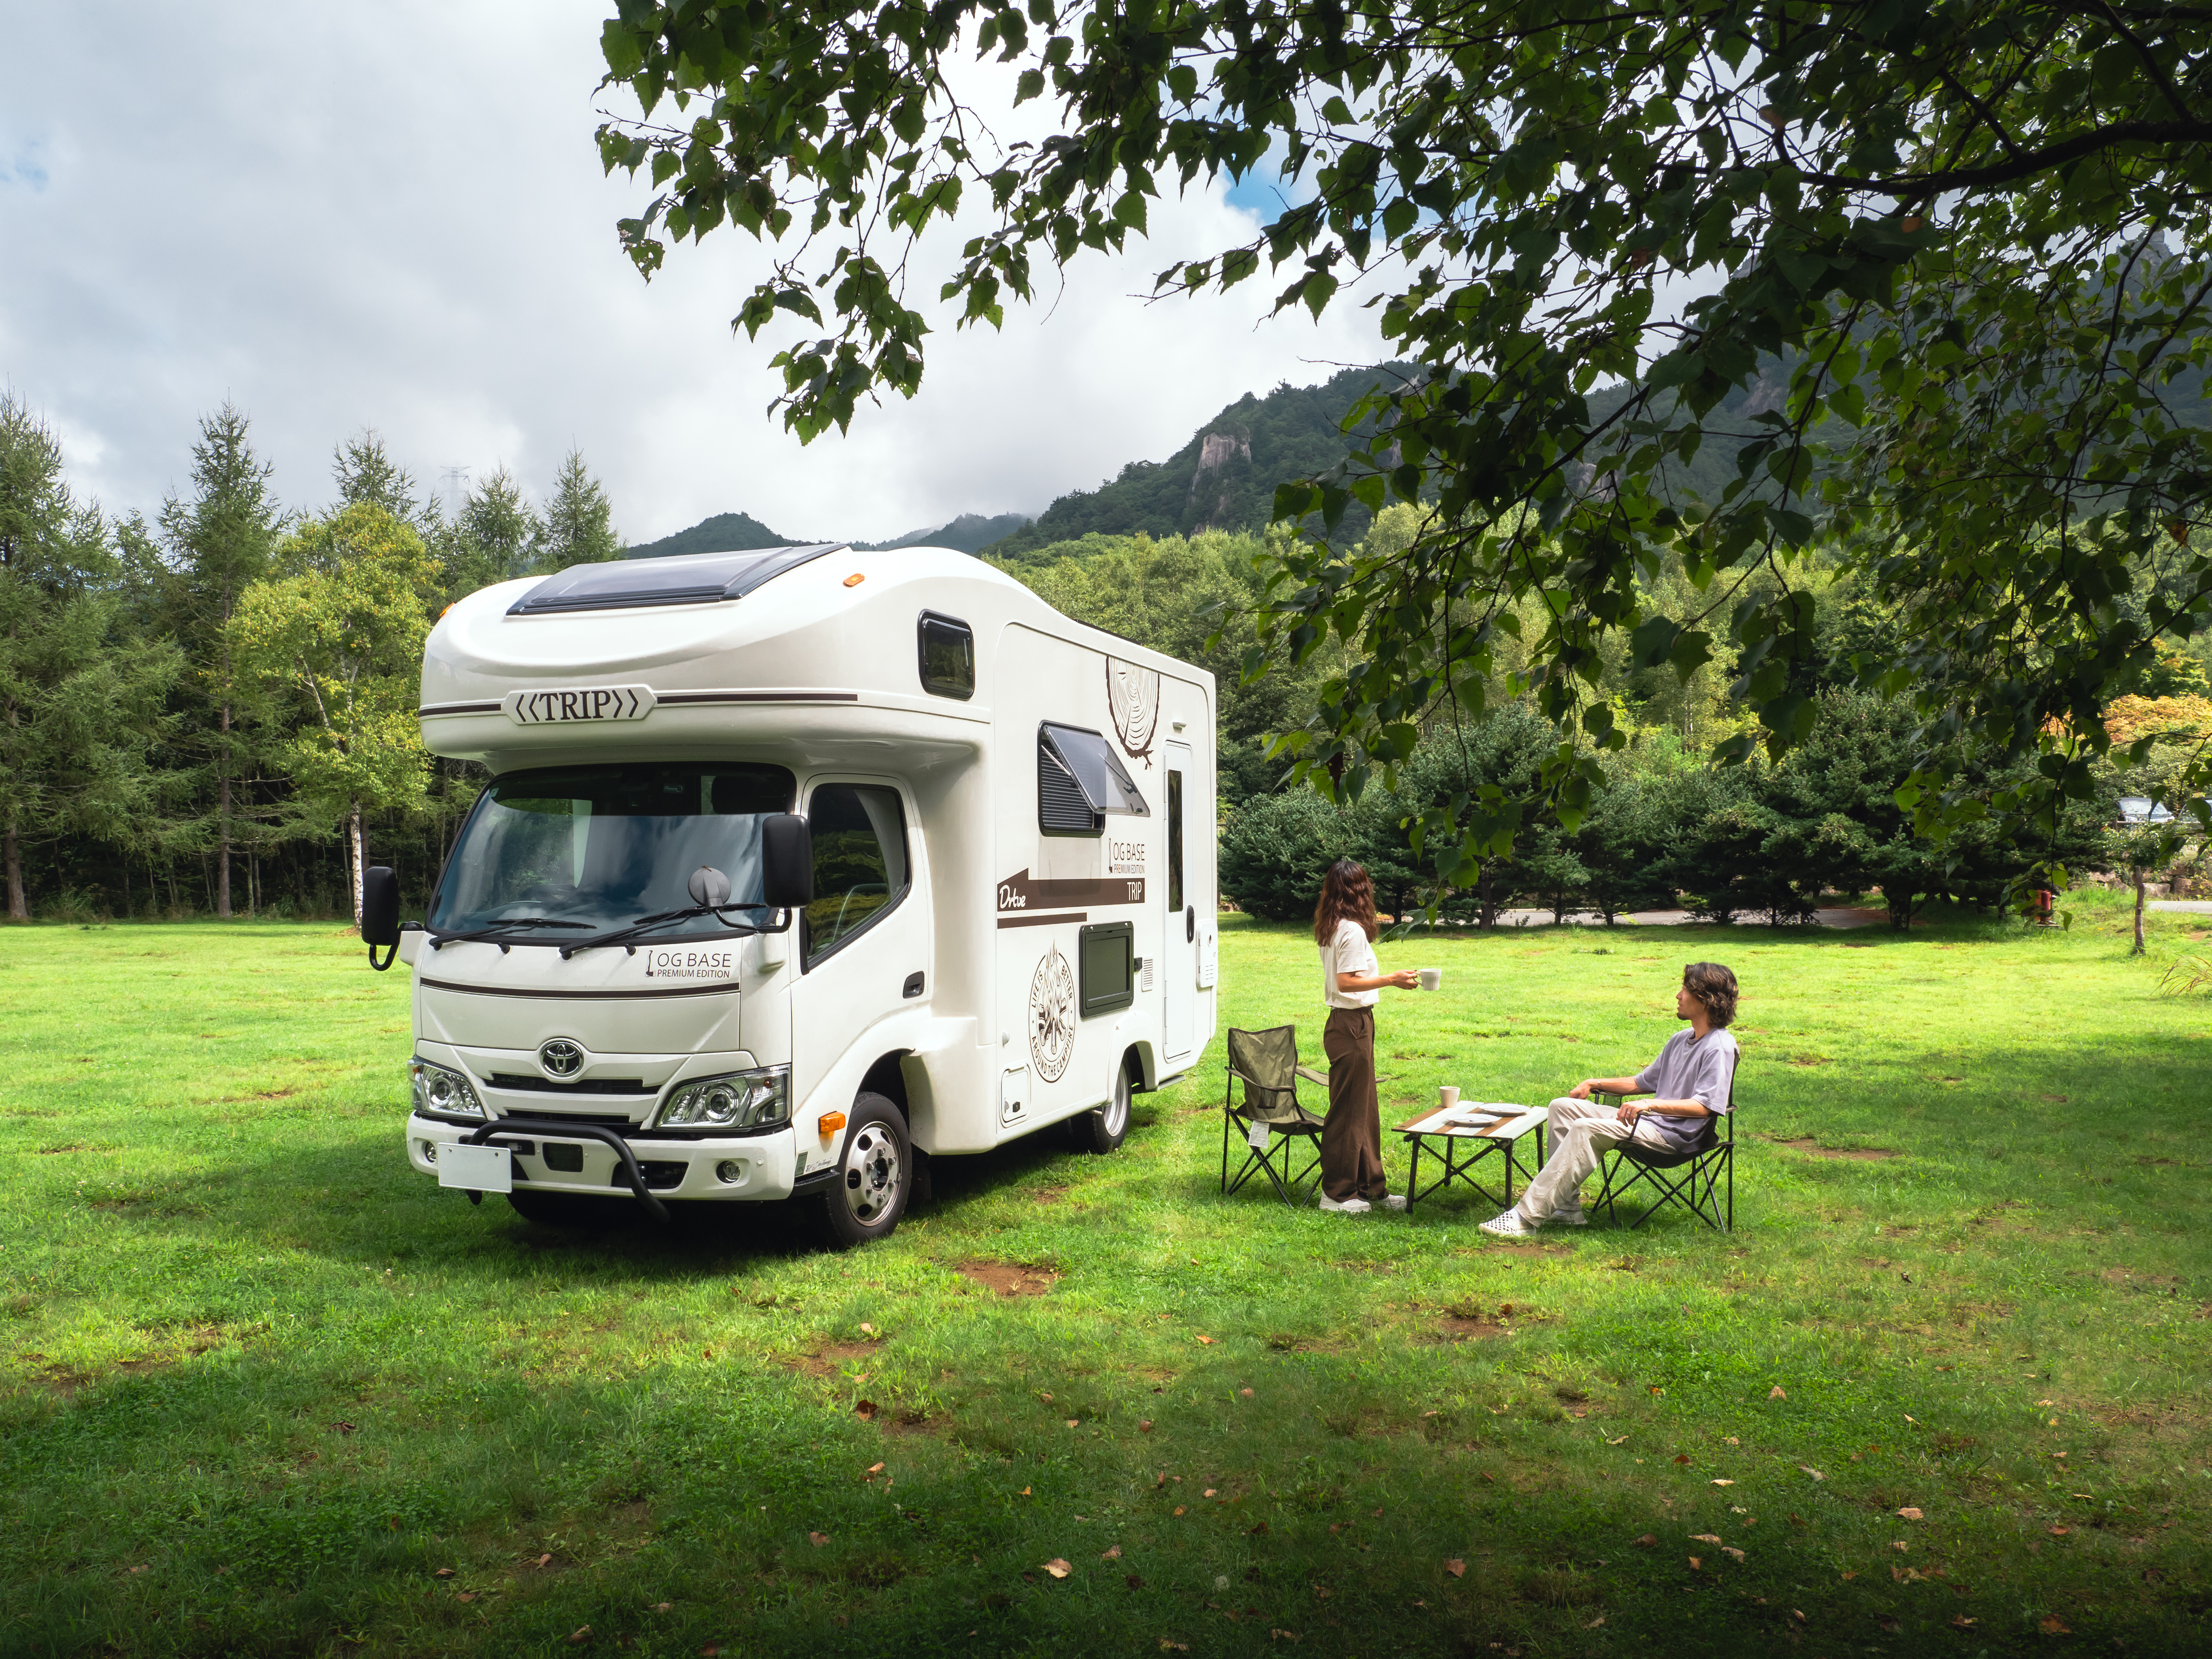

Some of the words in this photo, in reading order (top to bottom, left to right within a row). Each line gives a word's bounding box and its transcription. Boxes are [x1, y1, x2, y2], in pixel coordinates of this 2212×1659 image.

[538, 690, 611, 721] TRIP
[1127, 843, 1145, 861] BASE
[1114, 864, 1131, 874] PREMIUM
[1131, 864, 1145, 874] EDITION
[1127, 881, 1142, 901] TRIP
[687, 953, 732, 968] BASE
[657, 969, 695, 977] PREMIUM
[697, 970, 730, 978] EDITION
[1031, 983, 1039, 1008] LIFE
[1037, 970, 1043, 985] IS
[1061, 964, 1073, 1001] BETTER
[1032, 1035, 1047, 1074] AROUND
[1048, 1064, 1056, 1077] THE
[1057, 1024, 1073, 1073] CAMPFIRE
